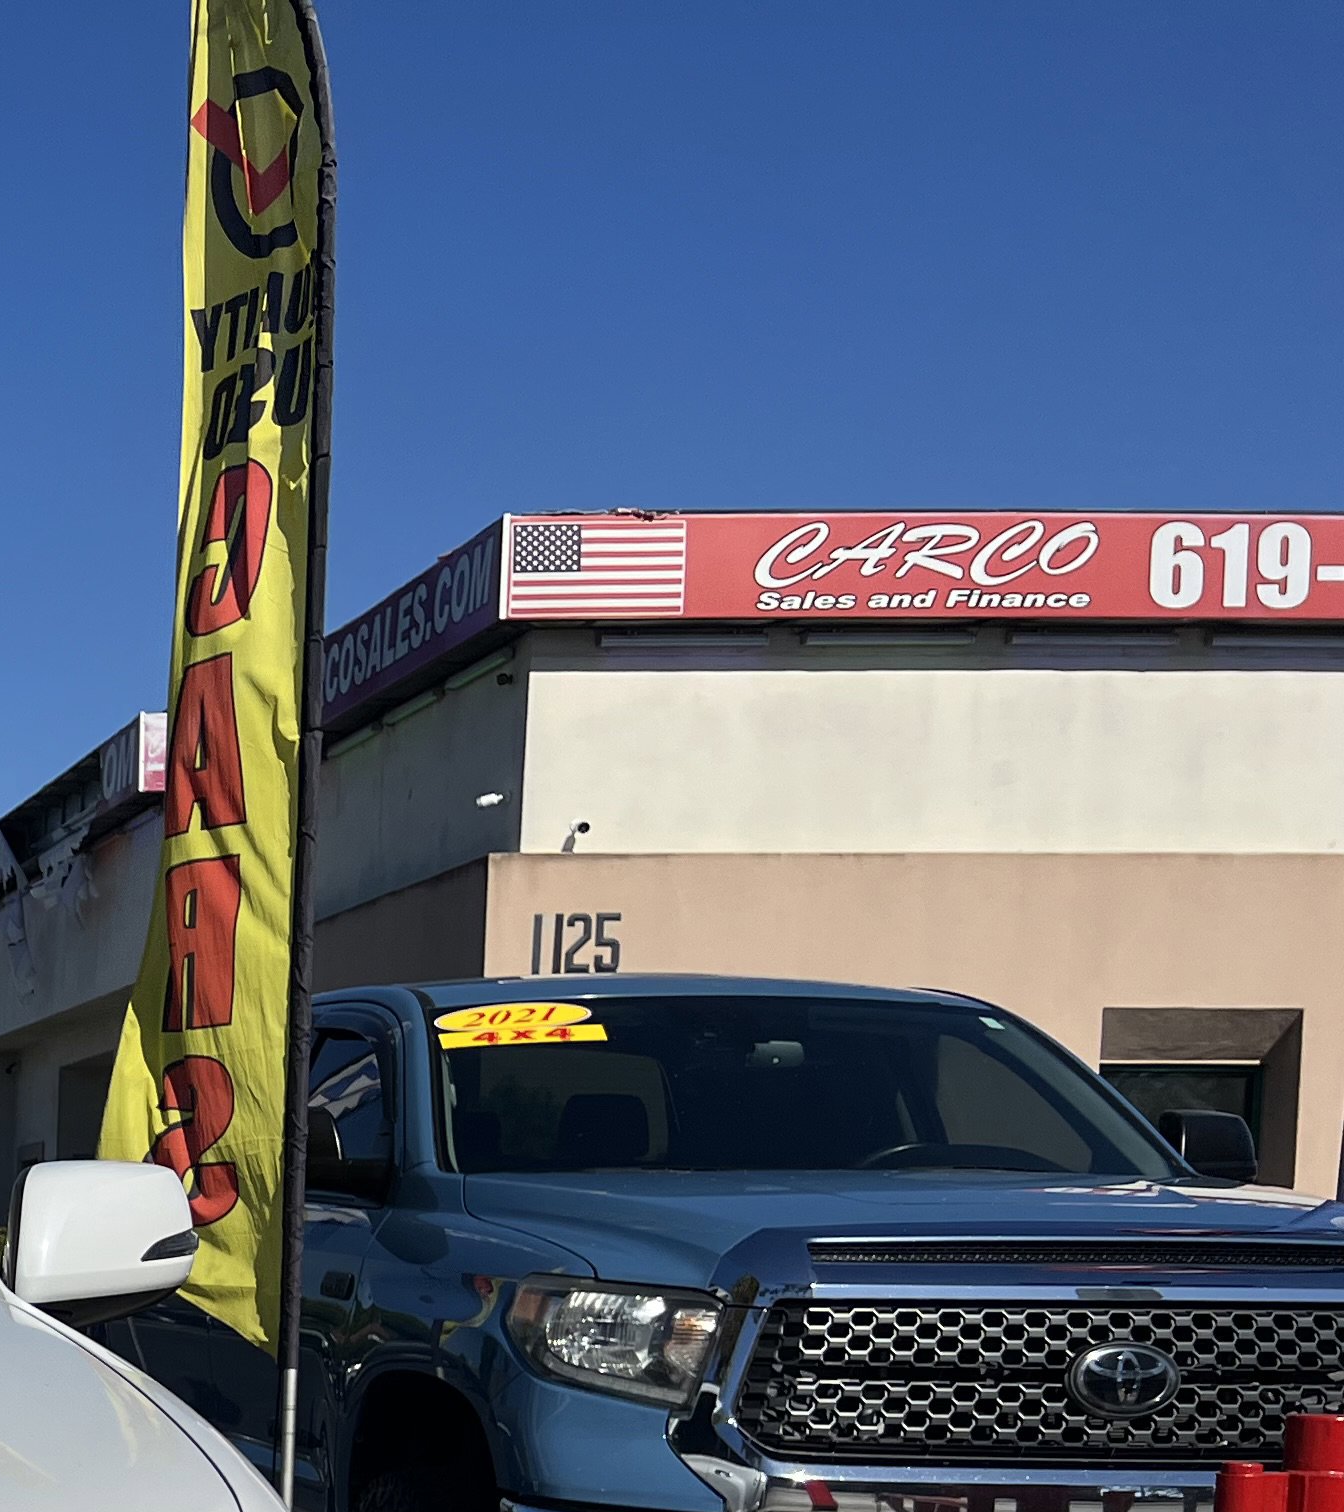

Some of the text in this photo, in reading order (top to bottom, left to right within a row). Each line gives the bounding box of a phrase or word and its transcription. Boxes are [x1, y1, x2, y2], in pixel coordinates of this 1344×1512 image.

[753, 519, 1100, 589] CARCO
[755, 590, 1091, 611] Sales and Finance
[531, 912, 622, 975] 1125
[462, 1006, 559, 1028] 2021
